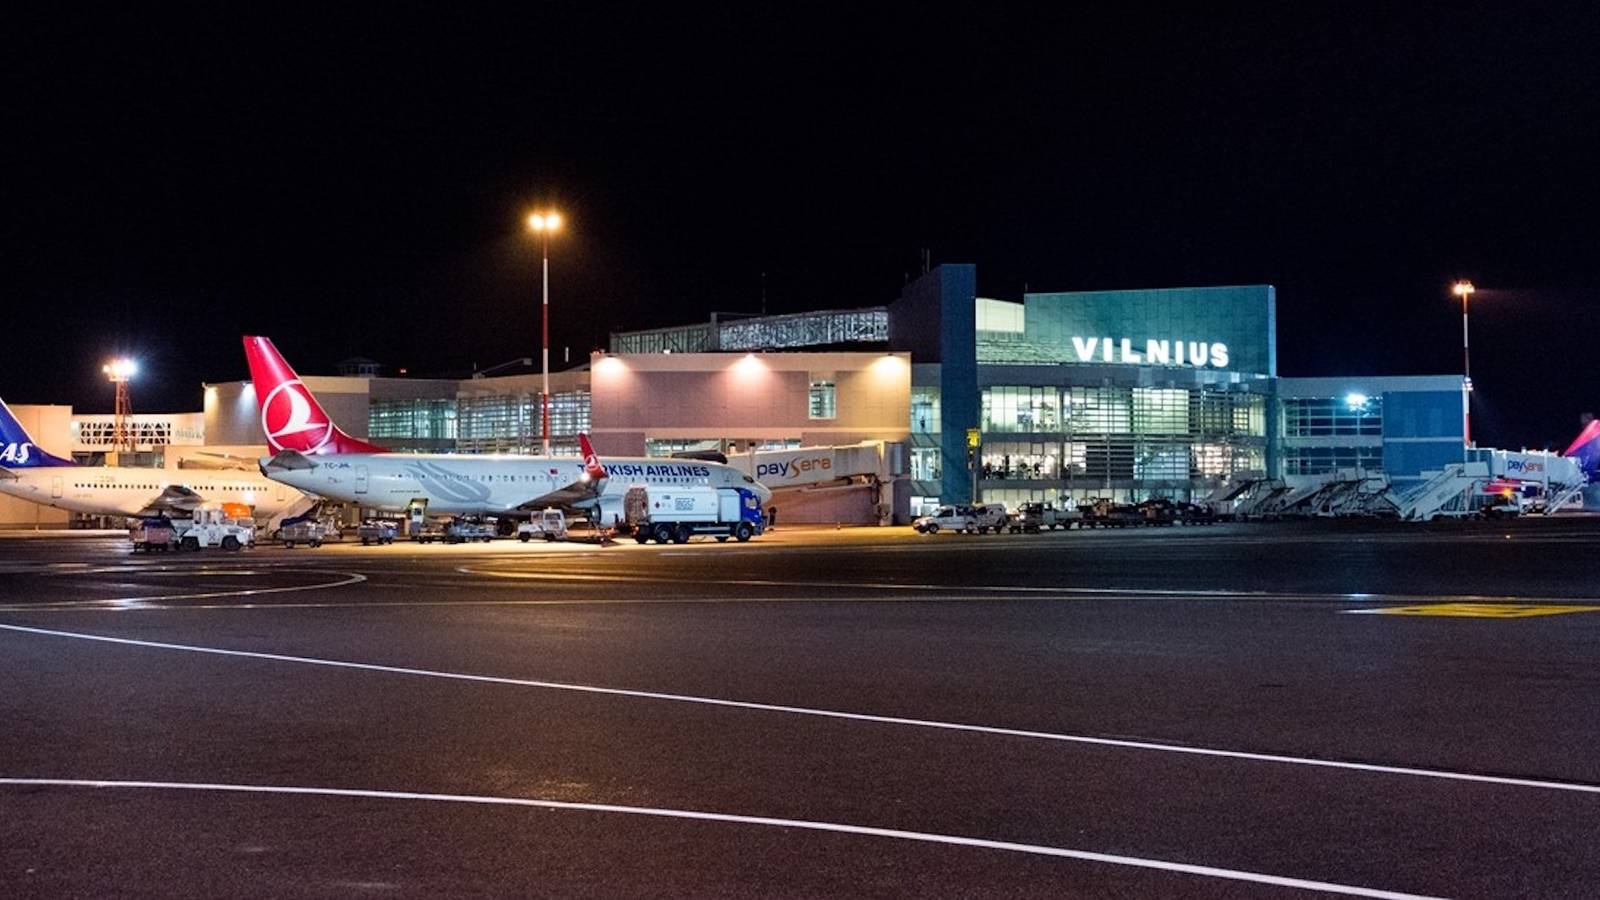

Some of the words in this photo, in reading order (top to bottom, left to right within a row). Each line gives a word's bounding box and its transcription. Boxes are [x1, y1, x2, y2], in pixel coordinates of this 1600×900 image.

[1071, 336, 1229, 368] VILNIUS
[577, 463, 643, 476] TKISH
[646, 464, 710, 477] AIRLINES
